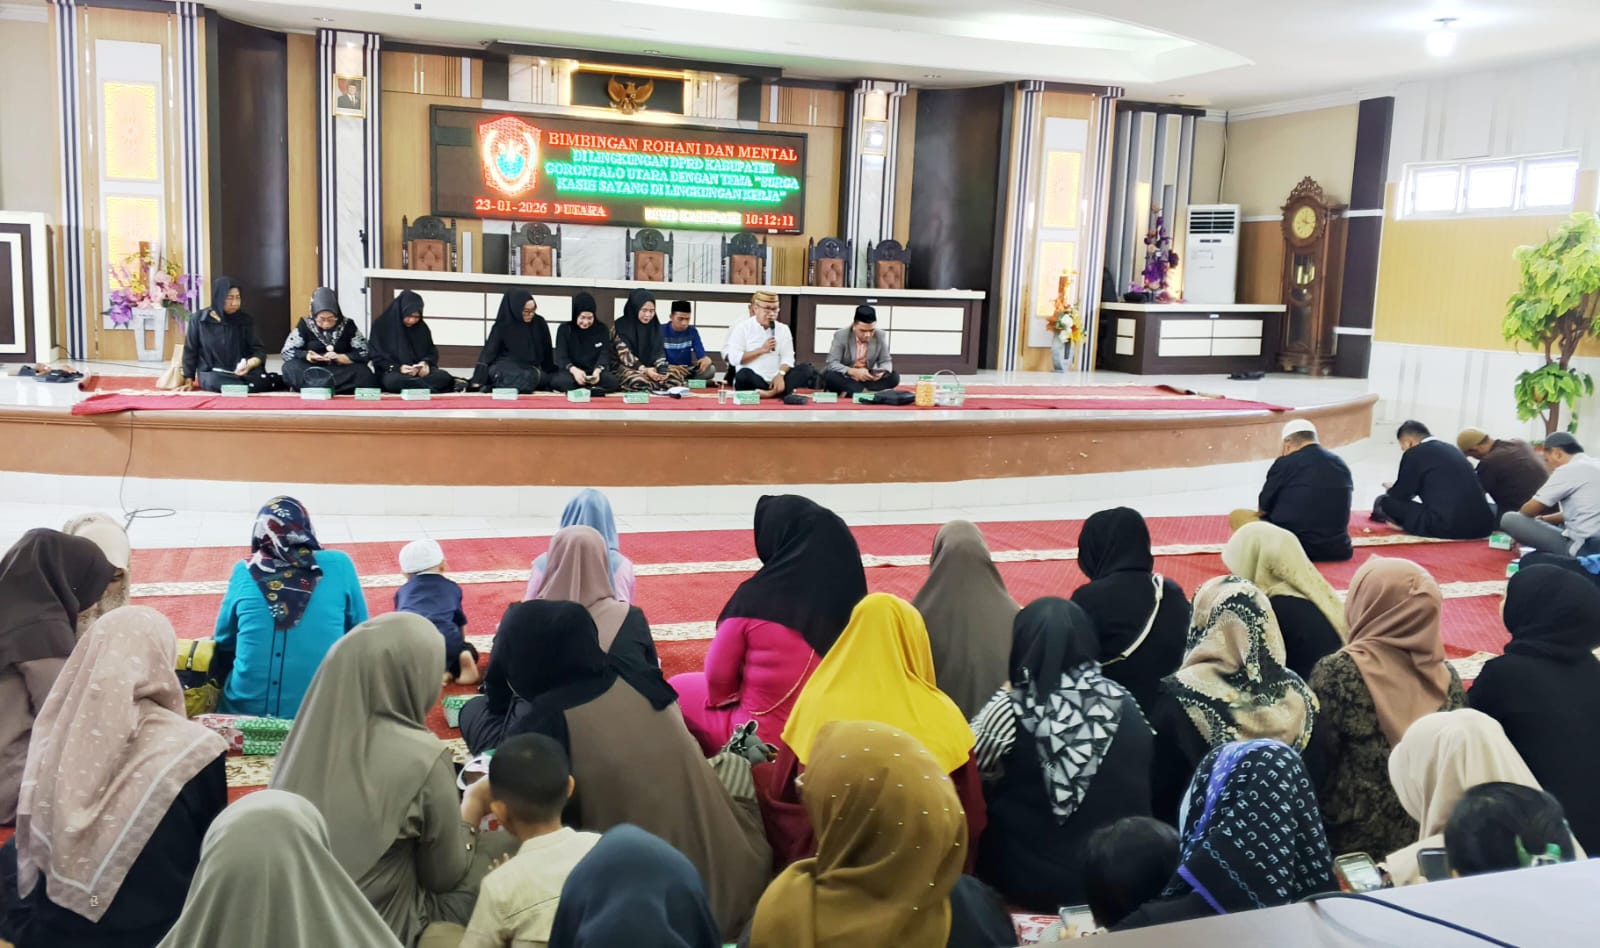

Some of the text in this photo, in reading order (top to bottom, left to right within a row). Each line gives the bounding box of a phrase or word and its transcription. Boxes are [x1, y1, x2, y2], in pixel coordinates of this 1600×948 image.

[548, 131, 798, 161] BIMBINGAN ROHANI DAN MENTAL
[573, 150, 775, 174] DI LINGKUNGAN DPRD KABUPATEN
[544, 162, 626, 179] GORONTALO
[627, 168, 669, 182] UTARA
[670, 170, 719, 184] DENGAN
[722, 173, 753, 187] TEMA
[557, 177, 598, 191] KASIH
[598, 180, 649, 195] SAYANG
[651, 183, 664, 195] DI
[665, 184, 742, 199] LINGKUNGAN
[475, 198, 548, 214] 23-01-2026
[745, 213, 794, 227] 10:12:11
